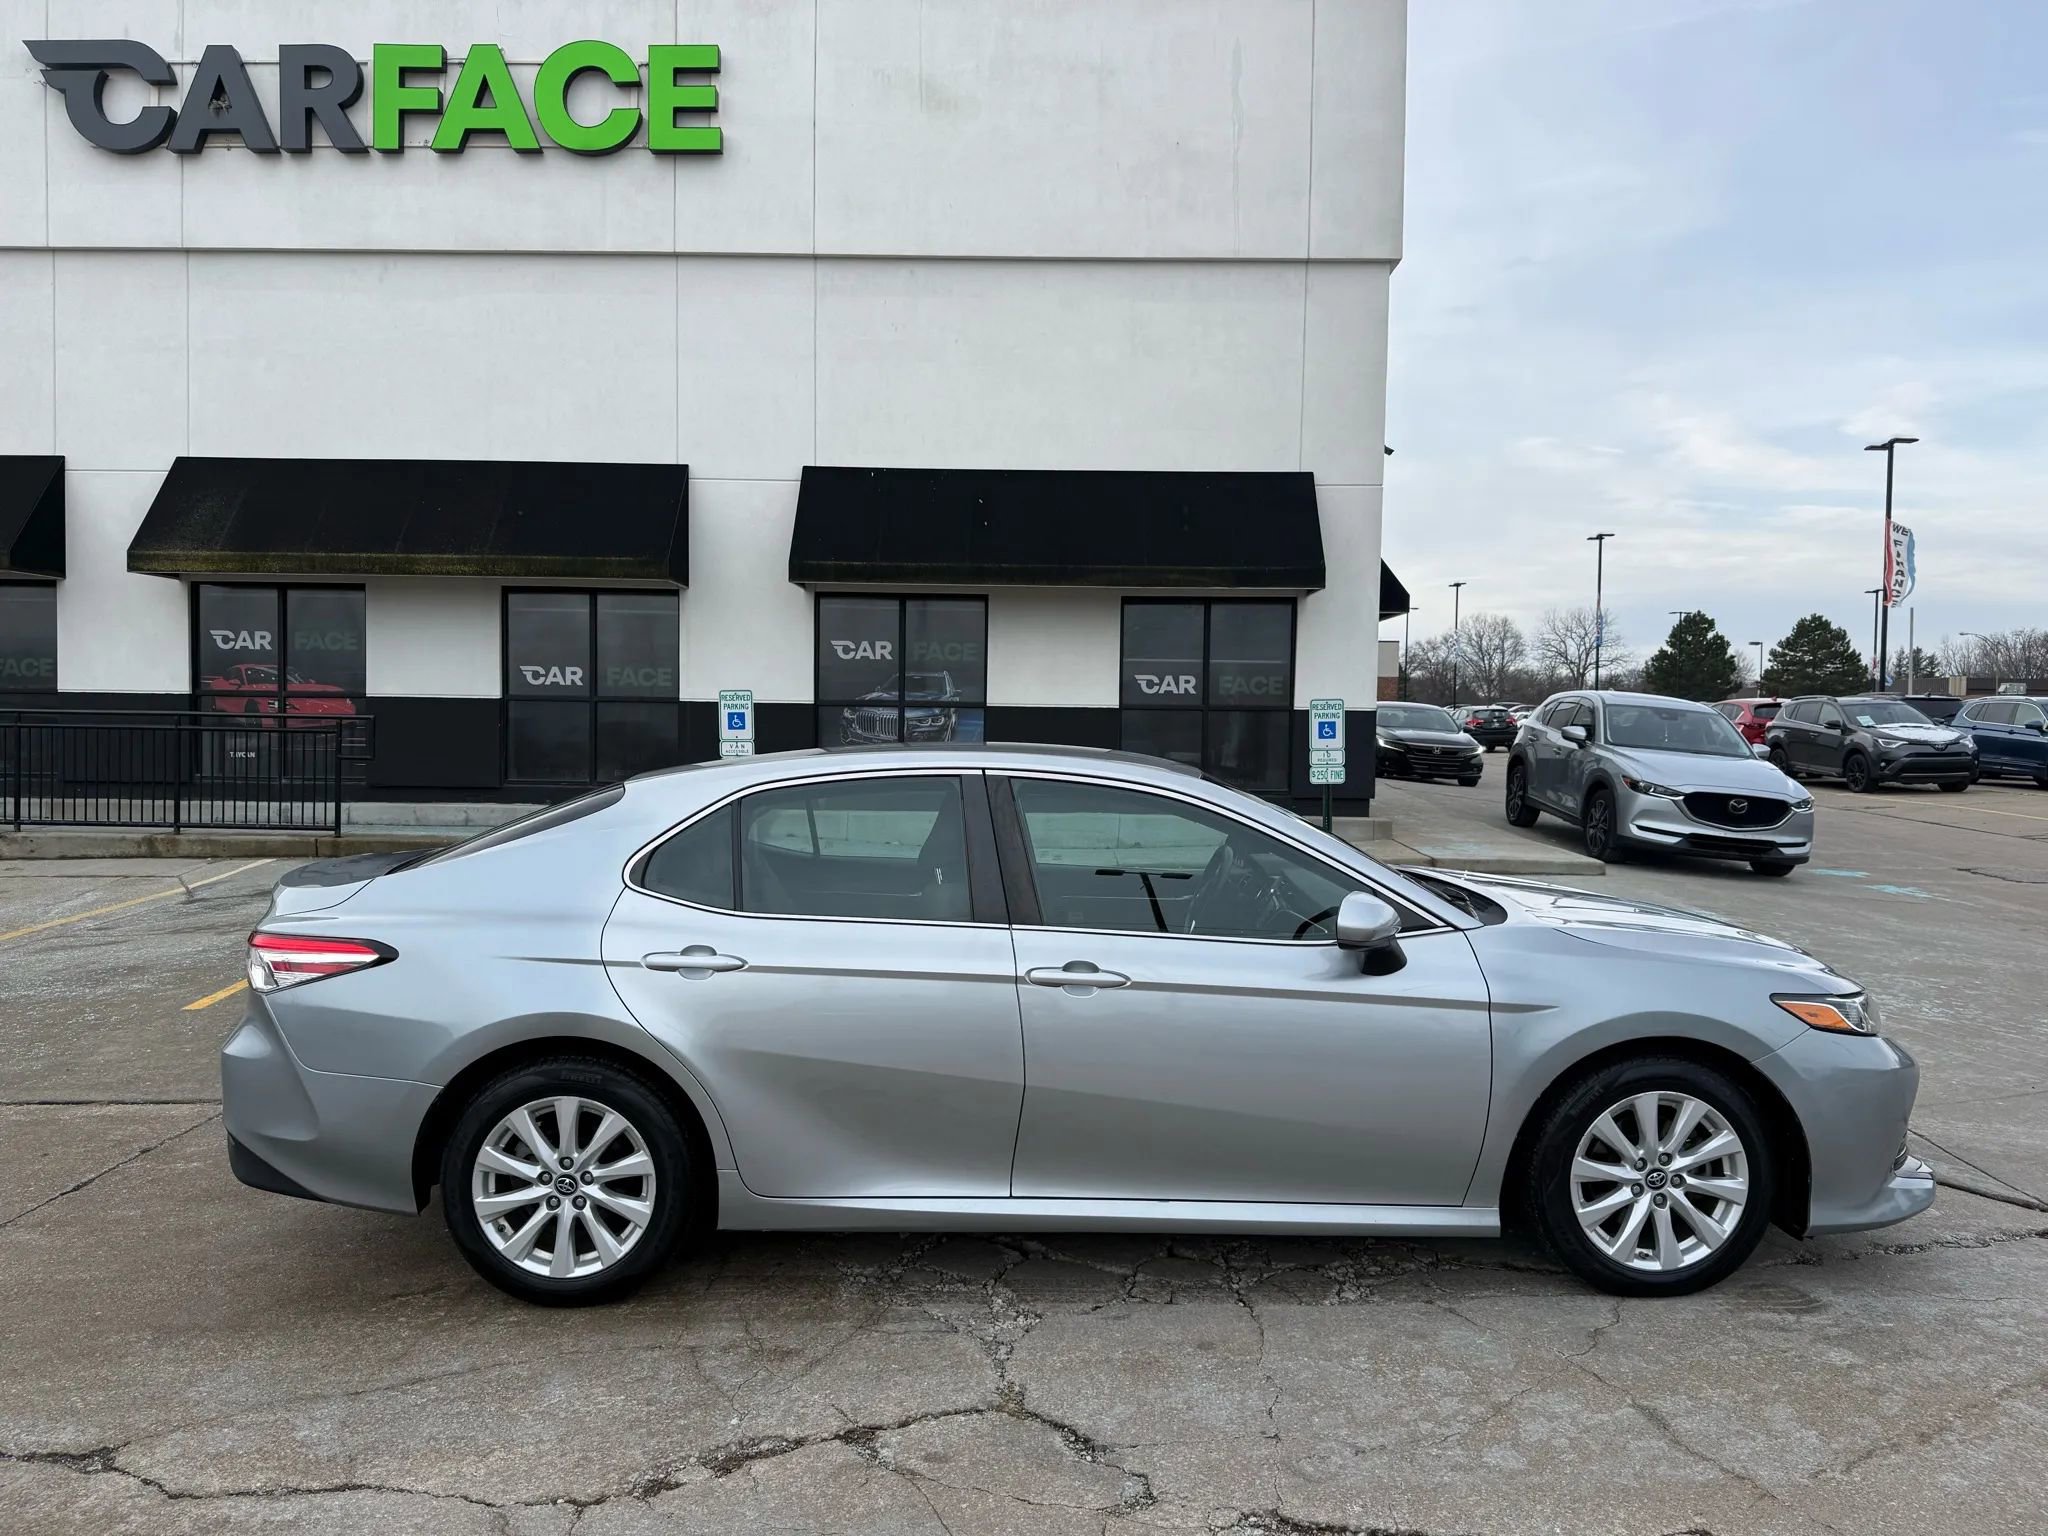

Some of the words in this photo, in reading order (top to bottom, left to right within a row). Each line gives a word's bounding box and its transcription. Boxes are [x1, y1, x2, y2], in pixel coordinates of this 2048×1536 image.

[1892, 523, 1909, 536] WE
[209, 630, 272, 650] CAR
[294, 631, 359, 650] FACE
[830, 640, 894, 660] CAR
[913, 641, 977, 661] FACE
[519, 665, 583, 686] CAR
[607, 667, 672, 687] FACE
[1134, 674, 1197, 695] CAR
[1218, 675, 1284, 695] FACE
[1330, 770, 1344, 780] FINE
